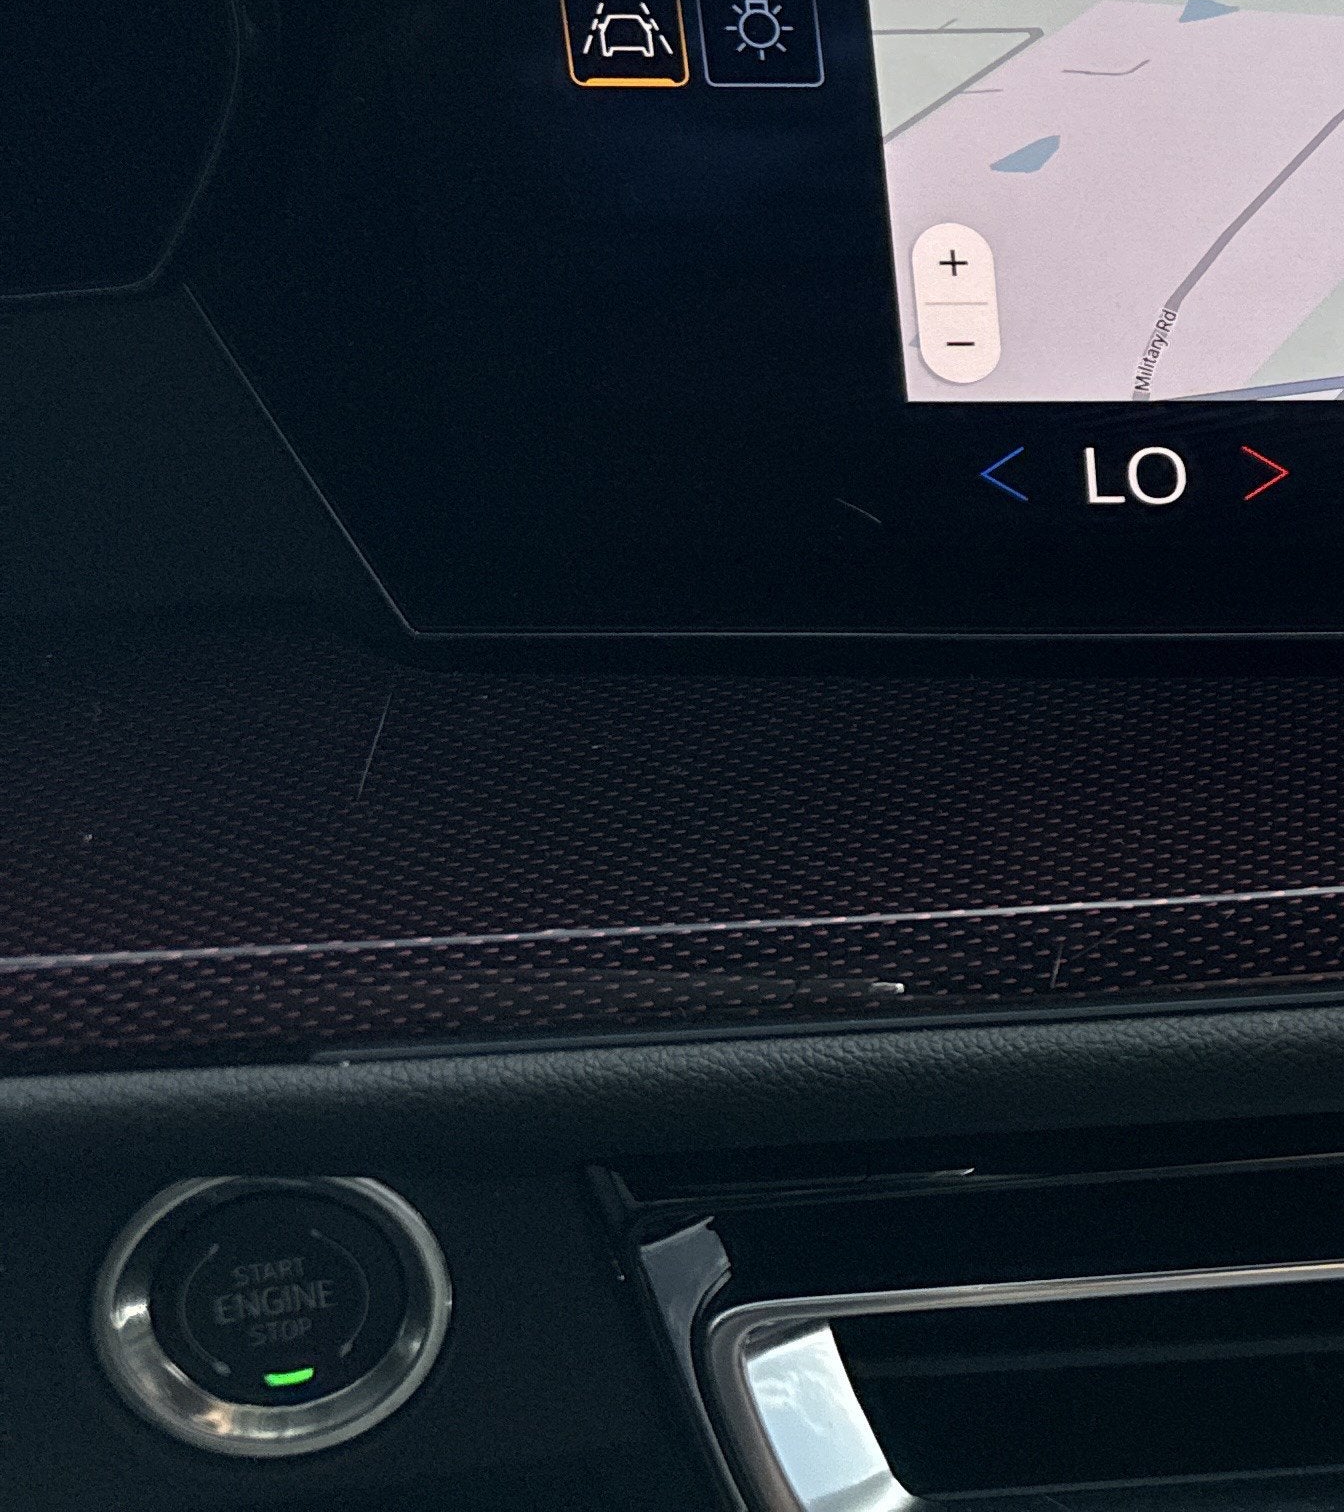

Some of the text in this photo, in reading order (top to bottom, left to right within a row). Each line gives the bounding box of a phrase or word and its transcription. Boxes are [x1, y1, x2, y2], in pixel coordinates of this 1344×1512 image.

[1134, 309, 1177, 392] Military Rd
[1083, 447, 1187, 505] LO
[234, 1257, 305, 1286] START
[214, 1280, 338, 1325] ENGINE
[250, 1317, 313, 1347] STOP
